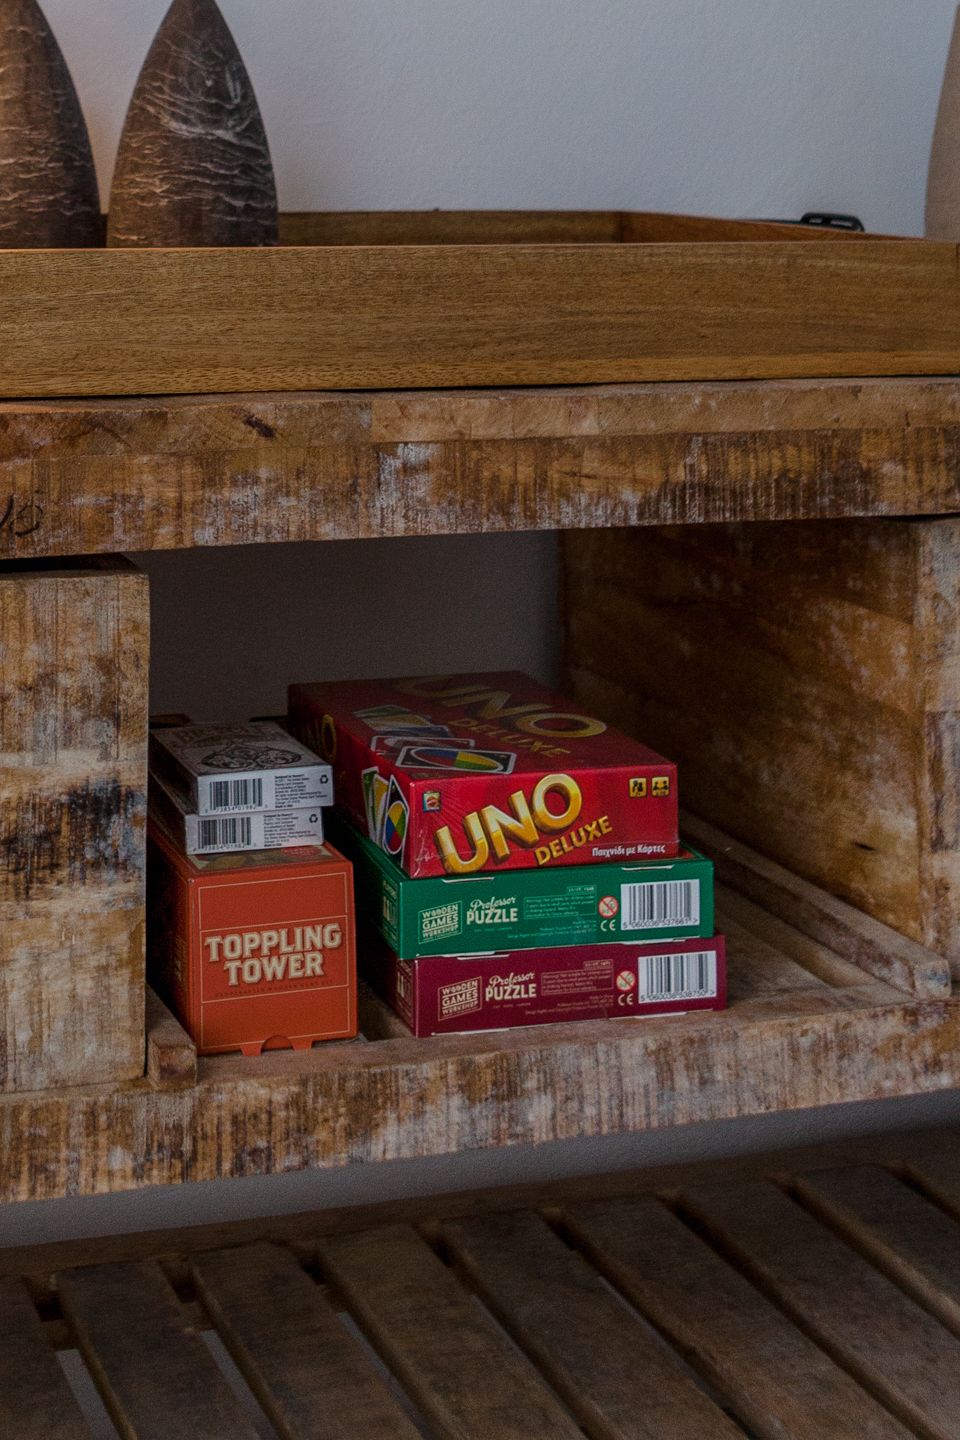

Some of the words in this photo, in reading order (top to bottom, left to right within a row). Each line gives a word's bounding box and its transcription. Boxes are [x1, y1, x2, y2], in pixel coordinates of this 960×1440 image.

[392, 674, 608, 738] UNO
[446, 717, 572, 759] DELUXE
[436, 773, 582, 874] UNO
[534, 815, 613, 866] DELUXE
[592, 845, 625, 858] Παιχνίδι
[626, 847, 636, 856] με
[637, 844, 666, 855] Κάρτες
[422, 904, 459, 919] WOODEN
[470, 896, 517, 912] Professor
[422, 914, 459, 931] GAMES
[466, 908, 519, 925] PUZZLE
[422, 924, 459, 939] WORKSHOP
[204, 922, 342, 962] TOPPLING
[224, 951, 324, 986] TOWER
[442, 979, 478, 995] WOODEN
[489, 972, 535, 988] Professor
[442, 989, 478, 1007] GAMES
[485, 983, 537, 1002] PUZZLE
[442, 1000, 478, 1015] WORKSHOP
